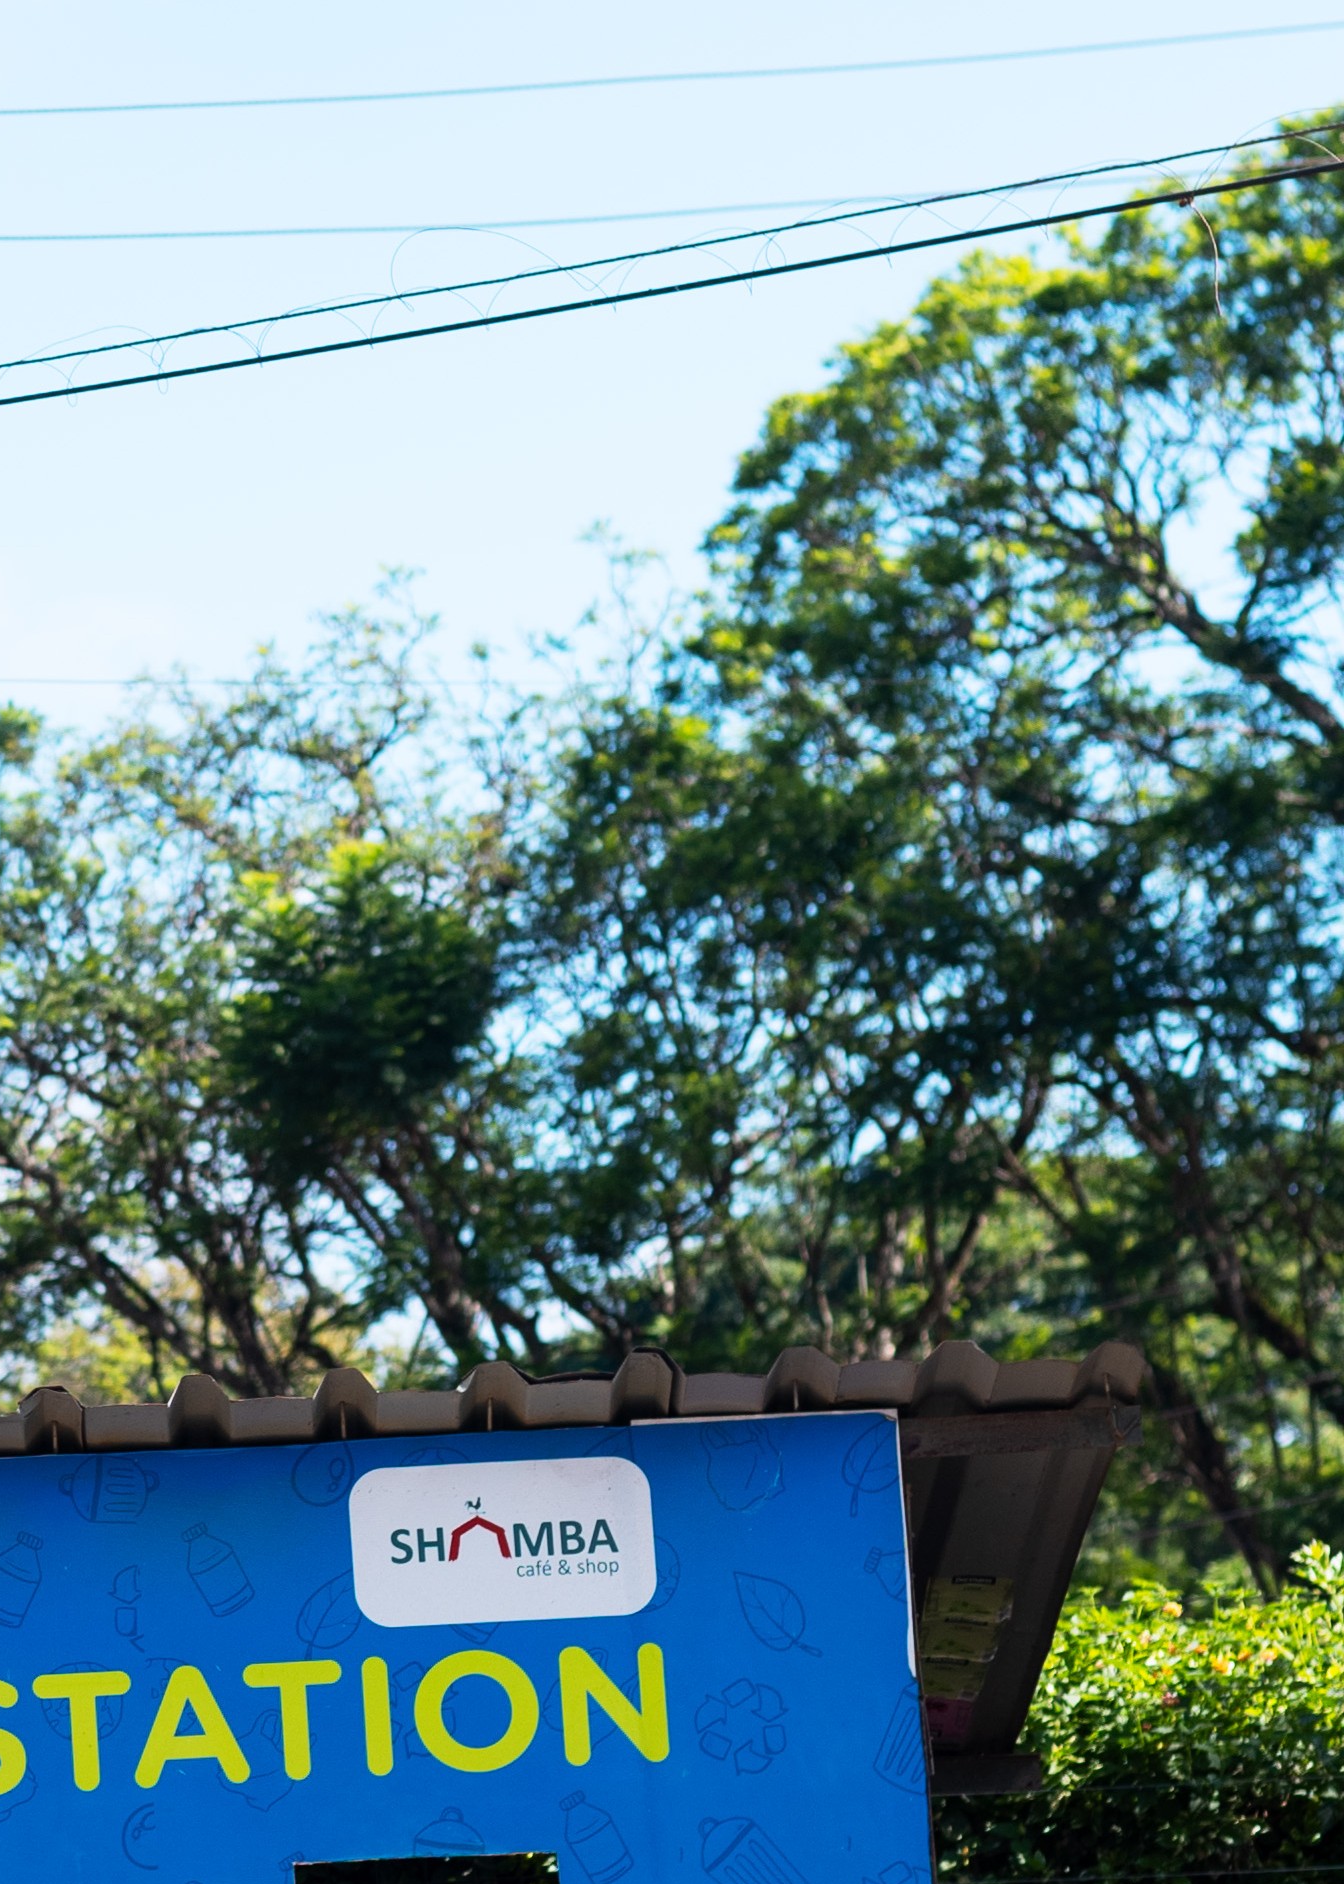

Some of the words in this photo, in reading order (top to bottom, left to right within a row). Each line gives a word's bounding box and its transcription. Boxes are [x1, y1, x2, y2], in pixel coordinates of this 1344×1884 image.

[391, 1516, 619, 1564] SHAMBA
[517, 1560, 552, 1577] café
[558, 1560, 571, 1575] &
[577, 1558, 619, 1576] shop
